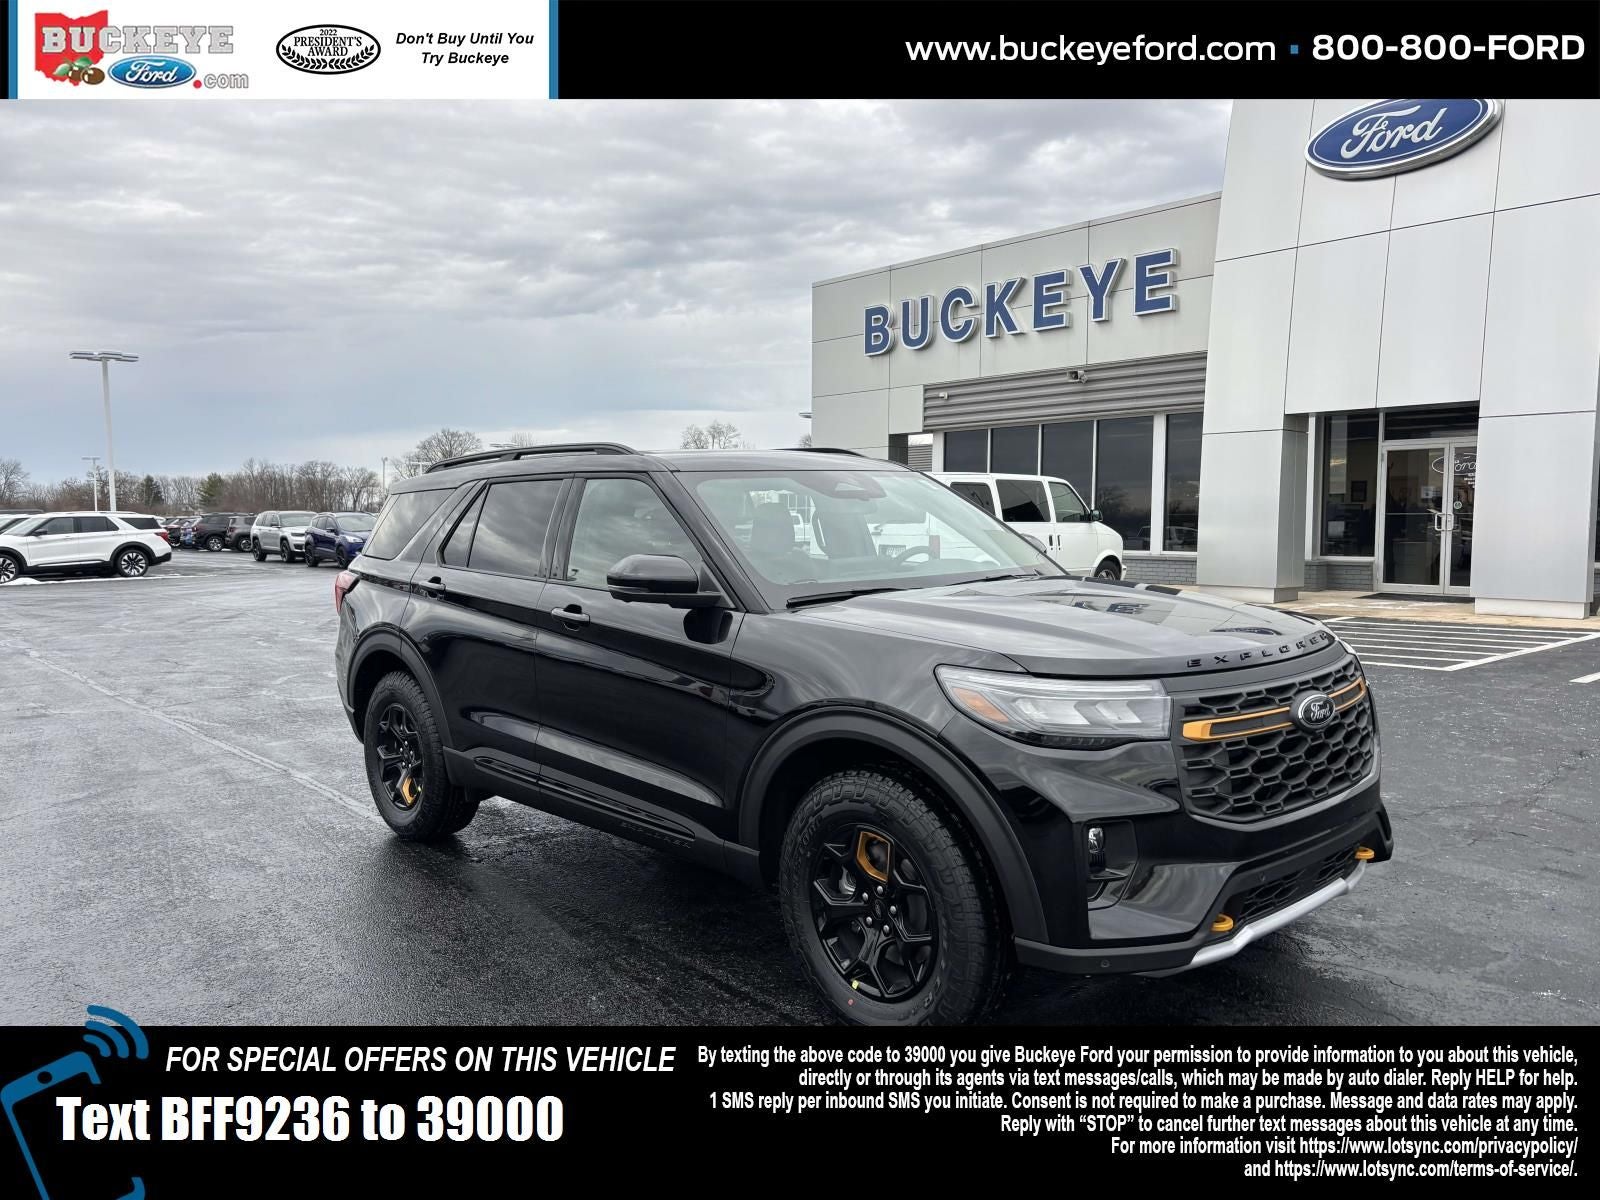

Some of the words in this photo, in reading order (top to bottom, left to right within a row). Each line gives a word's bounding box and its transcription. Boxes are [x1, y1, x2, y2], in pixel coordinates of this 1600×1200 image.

[1340, 105, 1447, 159] Ford
[863, 248, 1178, 357] BUCKEYE
[1186, 632, 1328, 668] EXPLORER
[1310, 702, 1330, 721] Ford
